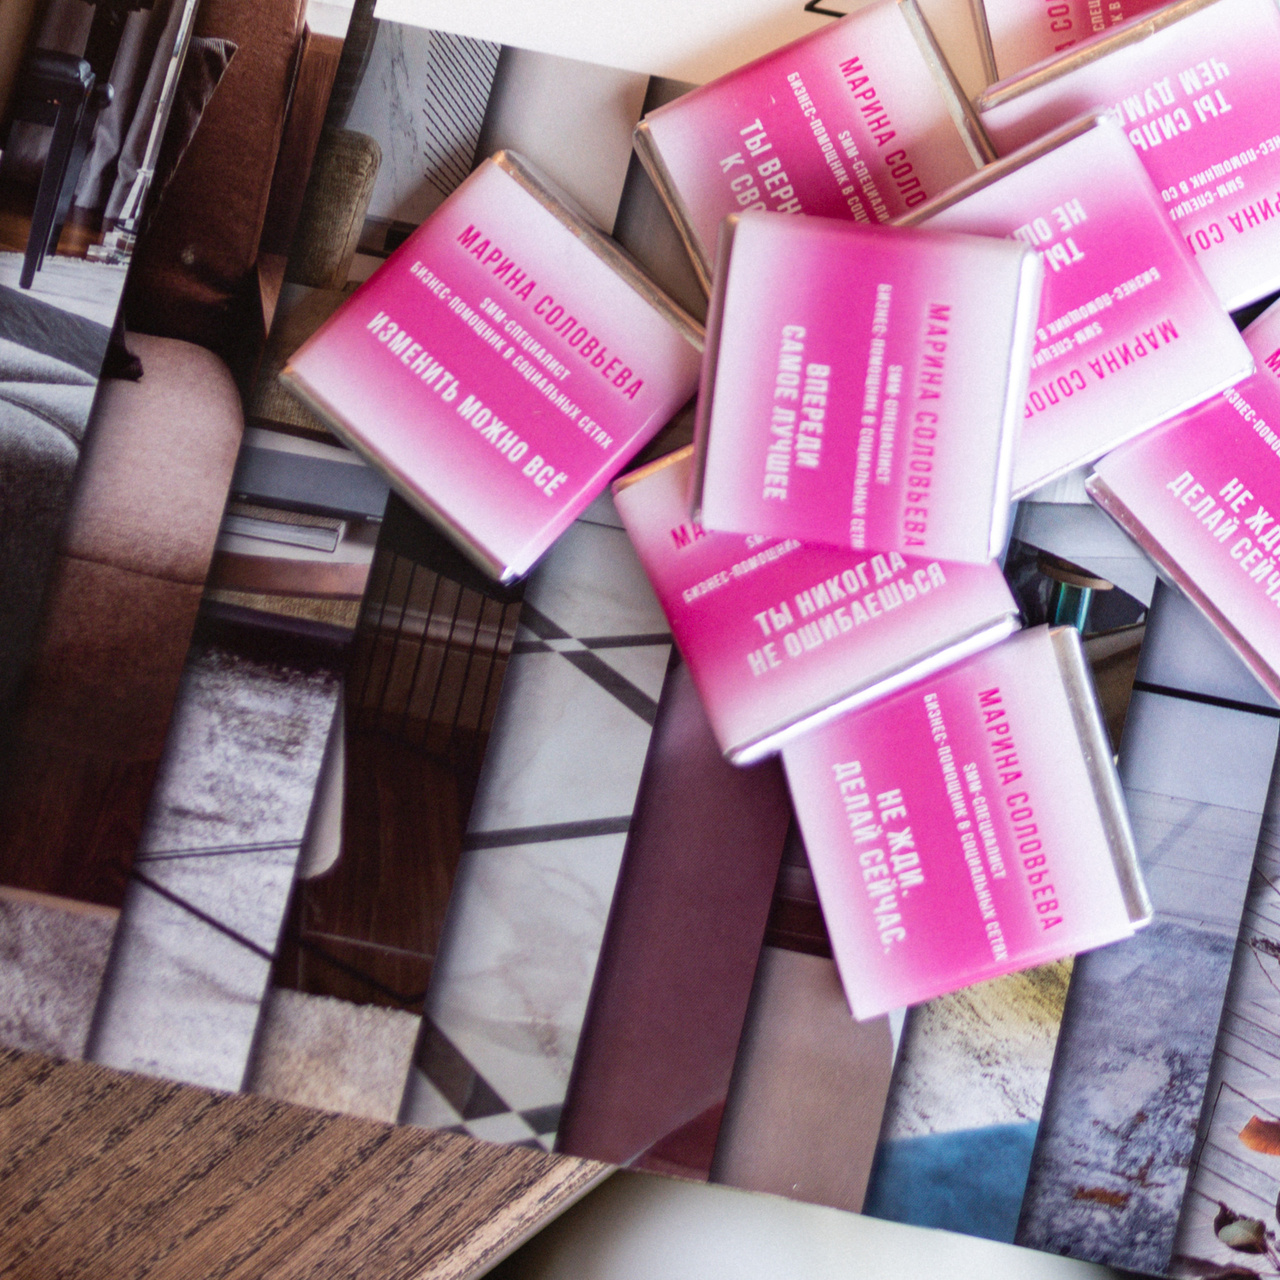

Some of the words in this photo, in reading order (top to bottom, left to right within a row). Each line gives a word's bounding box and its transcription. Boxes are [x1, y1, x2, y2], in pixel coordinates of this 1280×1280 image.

[1107, 0, 1121, 10] В
[838, 54, 897, 148] МАРИНА
[1102, 77, 1178, 130] ДУМА
[1175, 51, 1230, 95] ЧЕМ
[1190, 86, 1232, 122] ТЫ
[717, 150, 744, 174] К
[737, 117, 773, 158] ТЫ
[756, 156, 802, 220] ВЕРН
[785, 70, 850, 186] БИЗНЕС-ПОМОЩНИК
[840, 183, 855, 196] В
[1126, 105, 1193, 154] СИЛЬ
[835, 128, 892, 224] SMM-СПЕЦИАЛИ
[1050, 196, 1088, 232] НЕ
[1177, 179, 1190, 194] В
[1042, 233, 1086, 272] ТЫ
[455, 223, 538, 302] МАРИНА
[531, 293, 646, 400] СОЛОВЬЕВА
[478, 296, 570, 382] SMM-СПЕЦИАЛИСТ
[1034, 326, 1048, 342] В
[1044, 265, 1160, 337] БИЗНЕС-ПОМОЩНИК
[409, 260, 507, 352] БИЗНЕС-ПОМОЩНИК
[501, 345, 516, 360] В
[510, 353, 581, 420] СОЦИАЛЬНЫХ
[576, 414, 614, 450] СЕТЯХ
[773, 323, 805, 400] САМОЕ
[918, 303, 949, 401] МАРИНА
[1086, 317, 1179, 381] МАРИНА
[364, 309, 464, 404] ИЗМЕНИТЬ
[455, 392, 530, 465] МОЖНО
[520, 453, 566, 497] ВСЁ
[792, 362, 830, 468] ВПЕРЕДИ
[862, 414, 877, 425] В
[762, 405, 796, 501] ЛУЧШЕЕ
[852, 427, 876, 515] СОЦИАЛЬНЫХ
[901, 410, 938, 548] СОЛОВЬЕВА
[1165, 466, 1240, 545] ДЕЛАЙ
[1216, 476, 1254, 514] НЕ
[745, 641, 783, 677] НЕ
[781, 560, 948, 659] ОШИБАЕШЬСЯ
[752, 600, 794, 638] ТЫ
[793, 544, 908, 618] НИКОГДА
[922, 692, 968, 818] БИЗНЕС-ПОМОЩНИК
[874, 787, 907, 823] НЕ
[956, 819, 972, 831] В
[961, 761, 1006, 880] SMM-СПЕЦИАЛИСТ
[977, 686, 1023, 785] МАРИНА
[1005, 790, 1064, 932] СОЛОВЬЕВА
[831, 757, 880, 845] ДЕЛАЙ
[856, 846, 911, 954] СЕЙЧАС.
[884, 826, 927, 898] ЖДИ.
[960, 831, 996, 920] СОЦИАЛЬНЫХ
[984, 920, 1008, 962] СЕТЯХ
